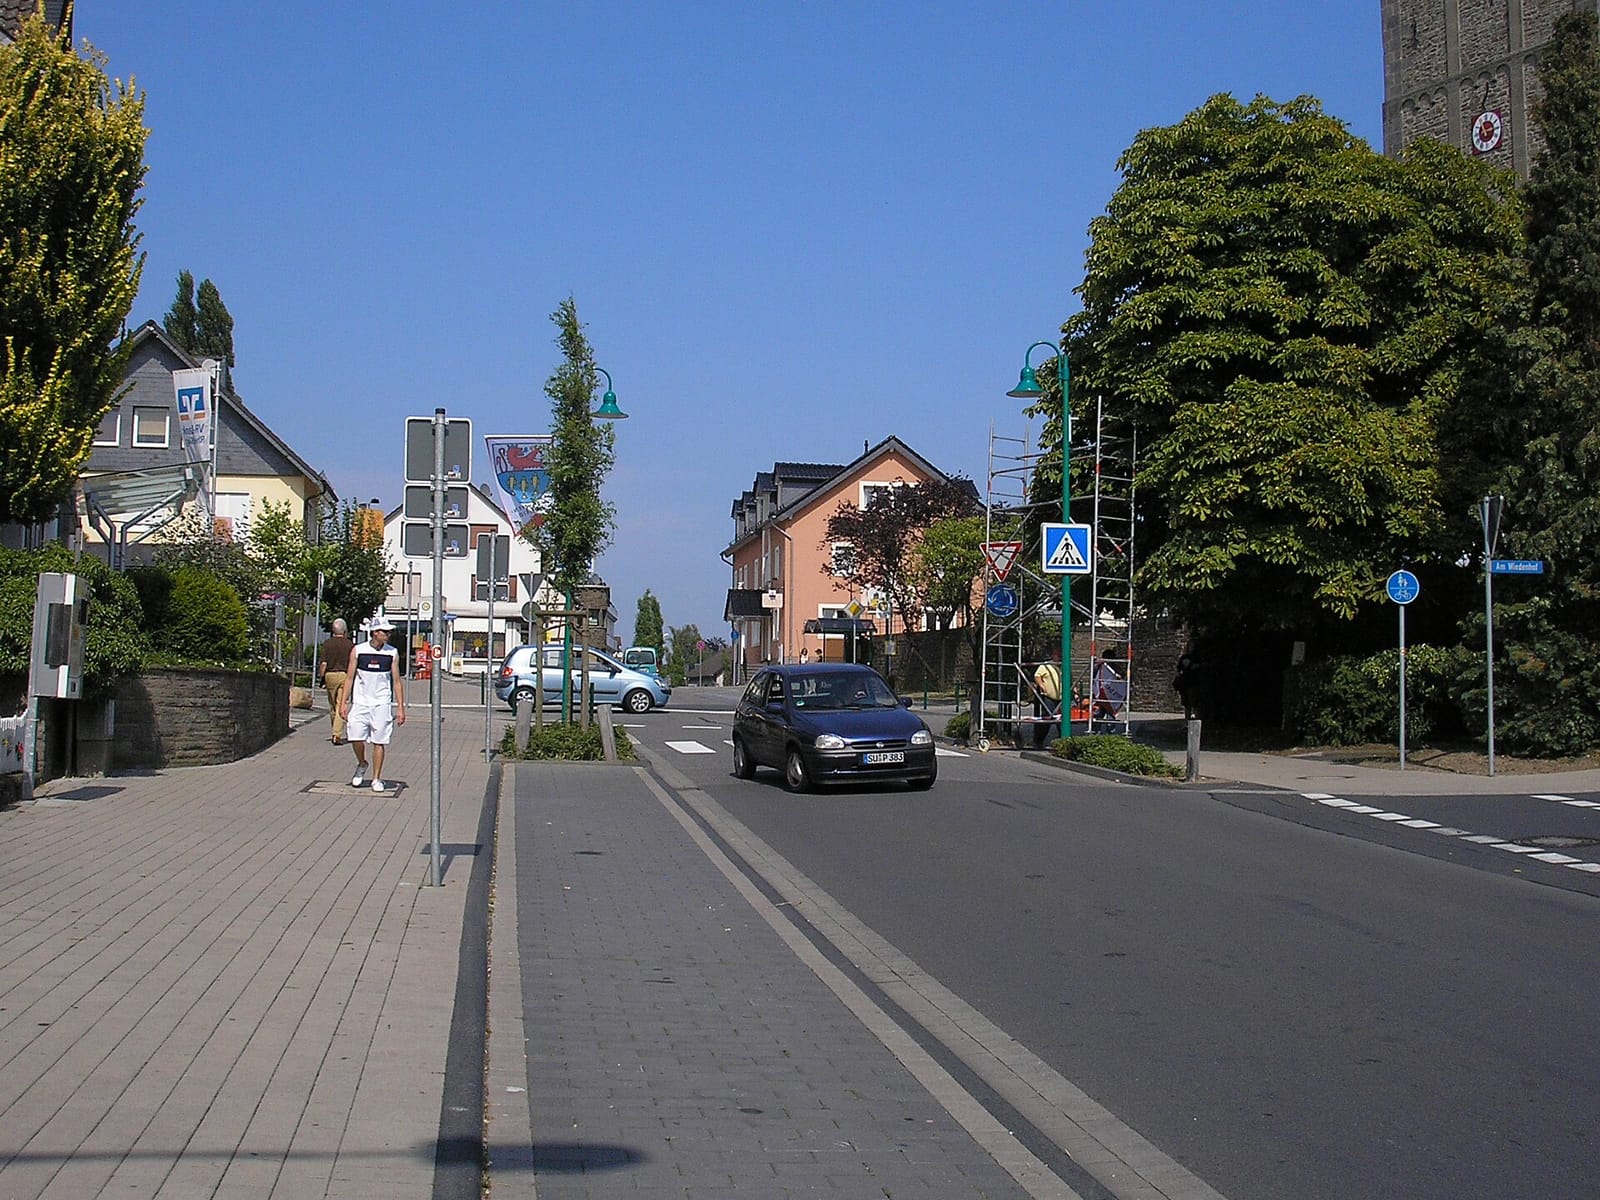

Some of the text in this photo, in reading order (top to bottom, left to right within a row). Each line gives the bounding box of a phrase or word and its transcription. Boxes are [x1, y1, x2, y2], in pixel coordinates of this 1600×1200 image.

[1496, 561, 1506, 570] Am
[867, 754, 878, 763] SU
[889, 752, 903, 761] 383
